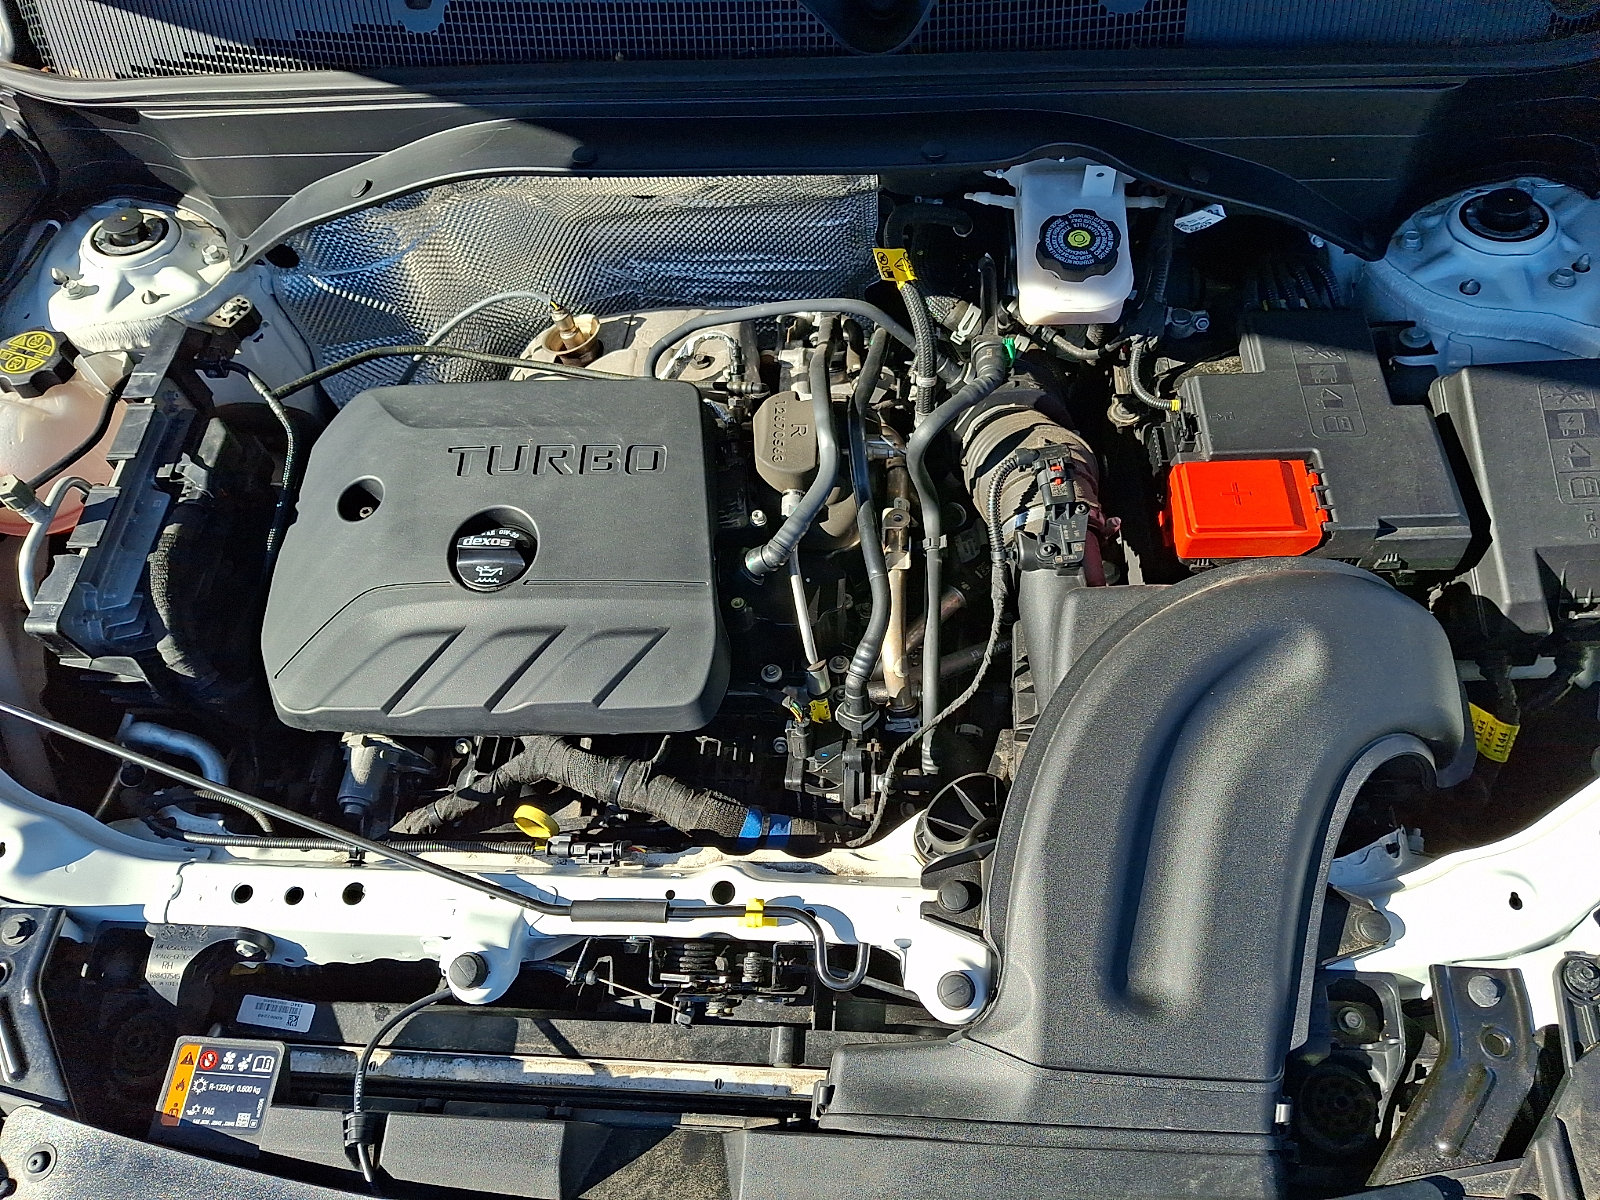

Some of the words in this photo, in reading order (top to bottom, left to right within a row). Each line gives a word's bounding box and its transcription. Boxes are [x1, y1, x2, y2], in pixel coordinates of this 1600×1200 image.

[790, 423, 809, 438] R
[447, 444, 668, 478] TURBO
[462, 535, 513, 547] dexos
[1492, 731, 1509, 754] 1144
[161, 961, 174, 970] RH
[219, 1063, 235, 1071] AUTO
[208, 1083, 235, 1095] R-1234yf
[236, 1084, 253, 1094] 0.600
[252, 1085, 262, 1095] kg
[202, 1106, 216, 1117] PAG
